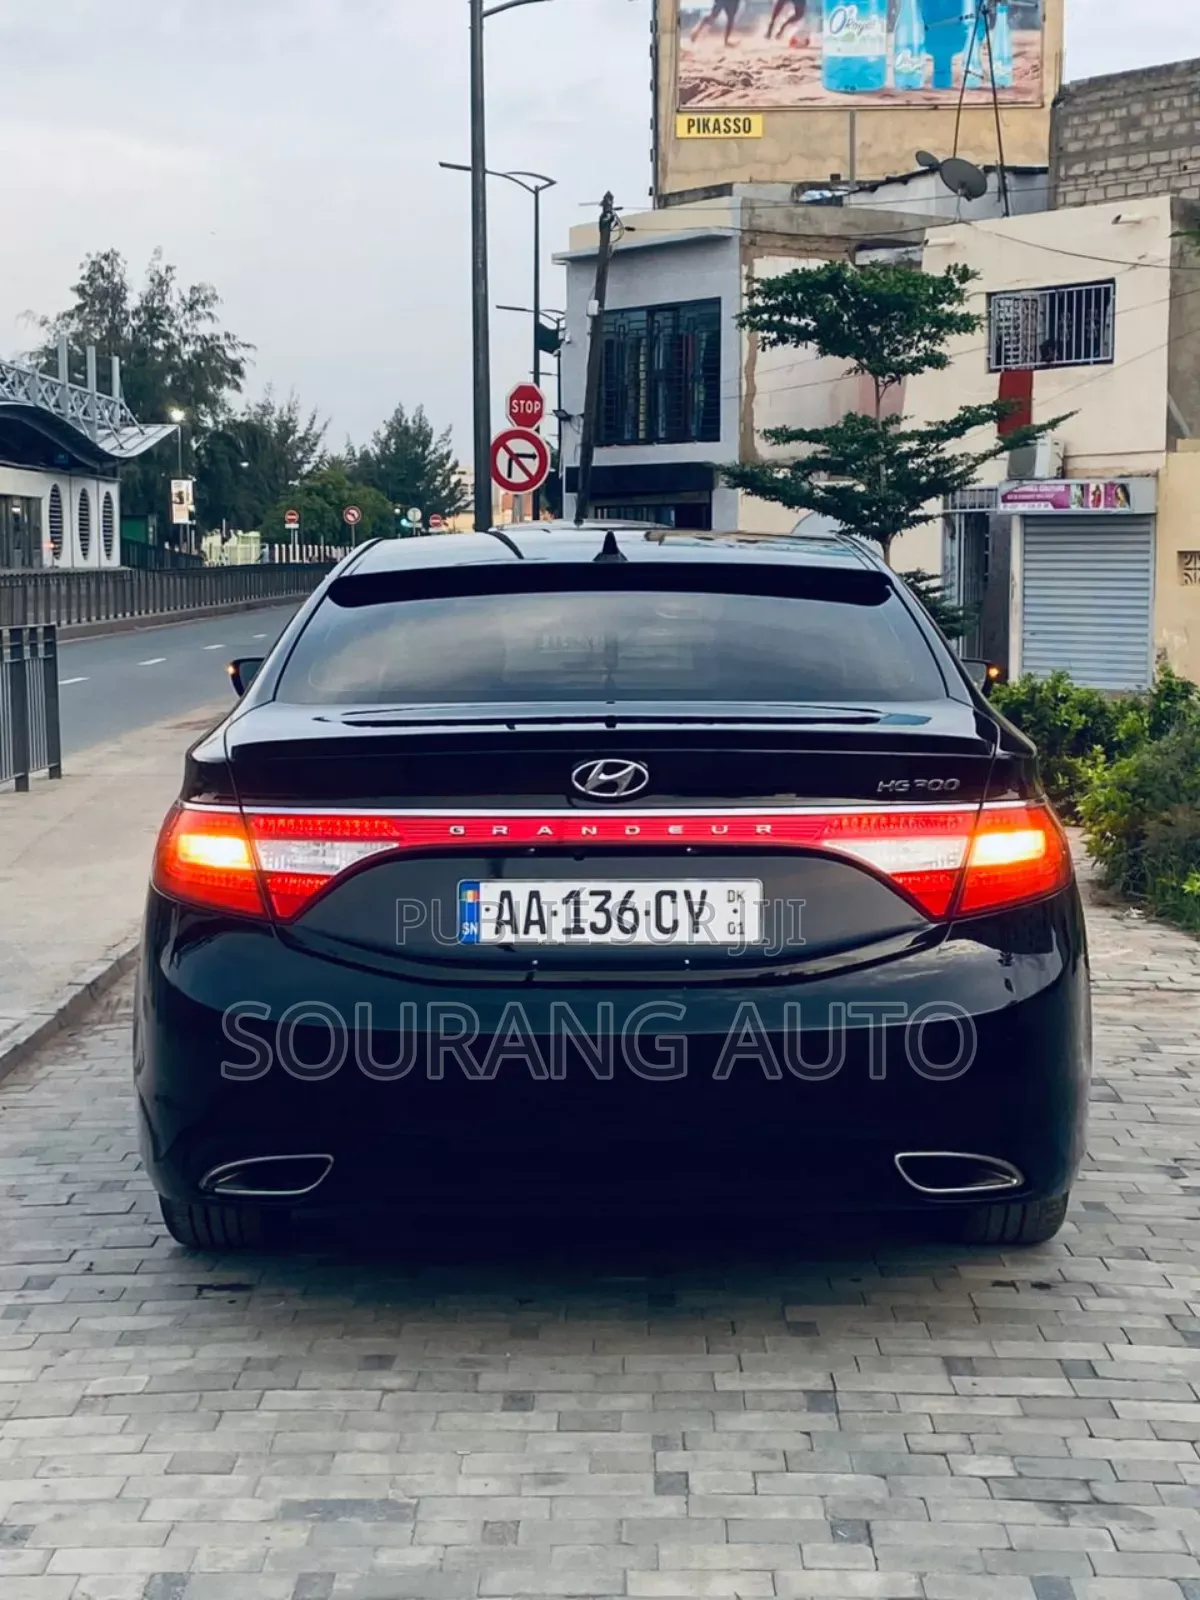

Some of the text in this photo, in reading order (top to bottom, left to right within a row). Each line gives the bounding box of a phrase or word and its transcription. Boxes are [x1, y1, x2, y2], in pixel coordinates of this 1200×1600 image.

[686, 116, 753, 135] PIKASSO
[511, 399, 542, 414] STOP
[876, 779, 909, 792] HG
[449, 824, 773, 837] GRANDEUR
[727, 889, 747, 904] DK
[461, 922, 479, 936] SN
